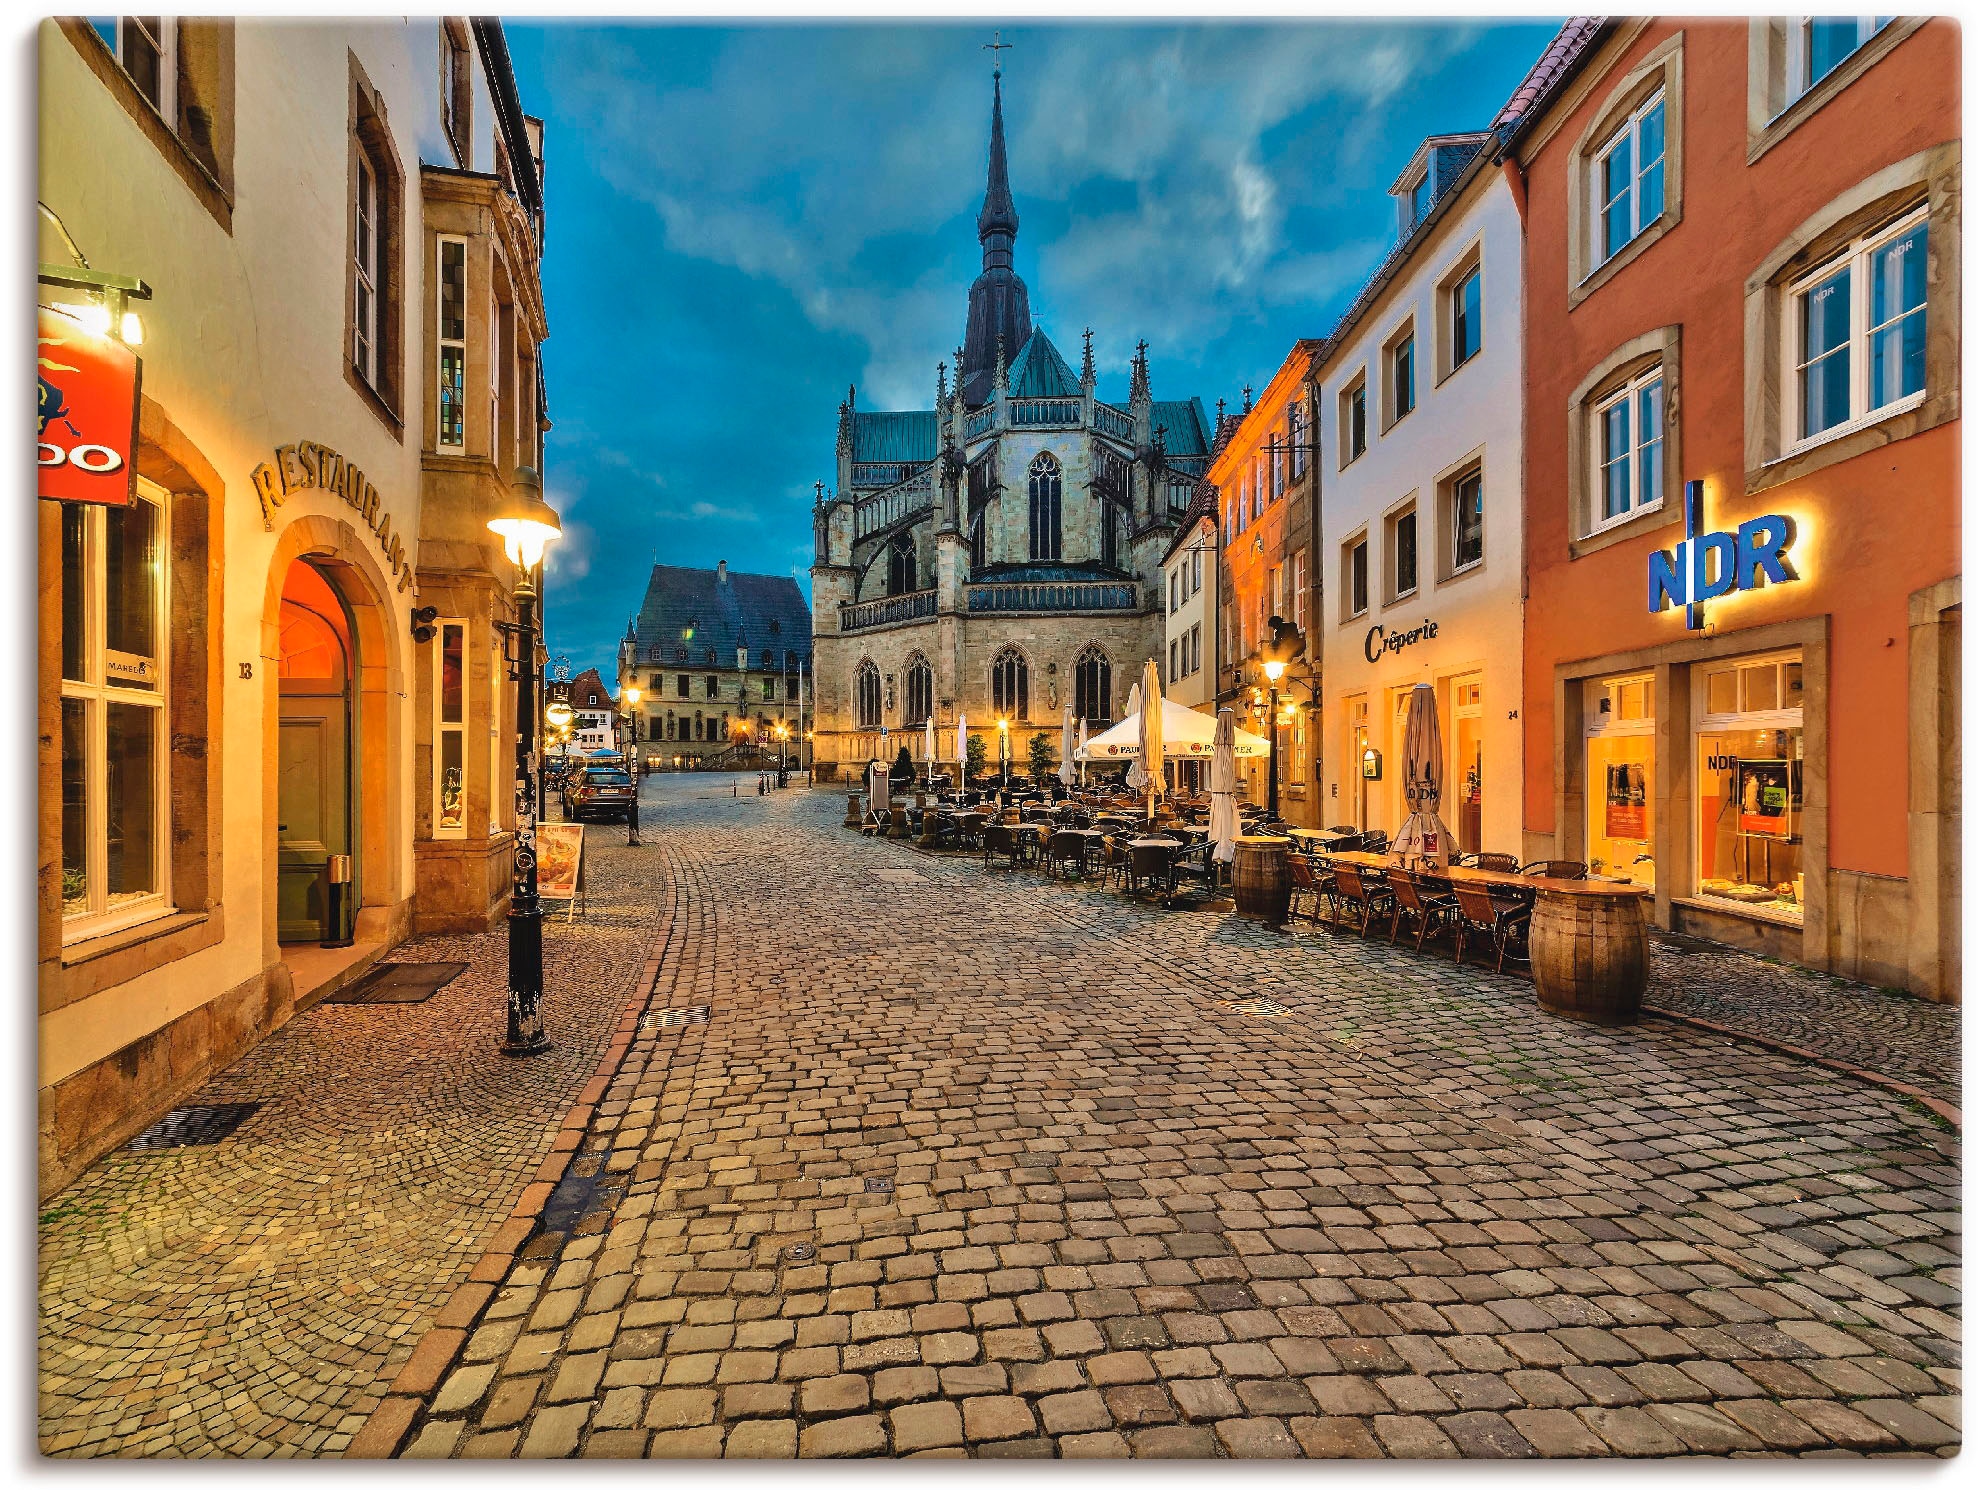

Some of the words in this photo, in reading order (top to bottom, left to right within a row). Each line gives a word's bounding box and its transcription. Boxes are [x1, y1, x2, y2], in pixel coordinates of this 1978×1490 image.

[1889, 239, 1913, 262] NDR
[1813, 286, 1835, 304] NDR
[250, 440, 412, 594] RESTAURANT
[1648, 514, 1793, 613] NDR
[1364, 618, 1439, 664] Crêperie
[238, 662, 253, 680] 13
